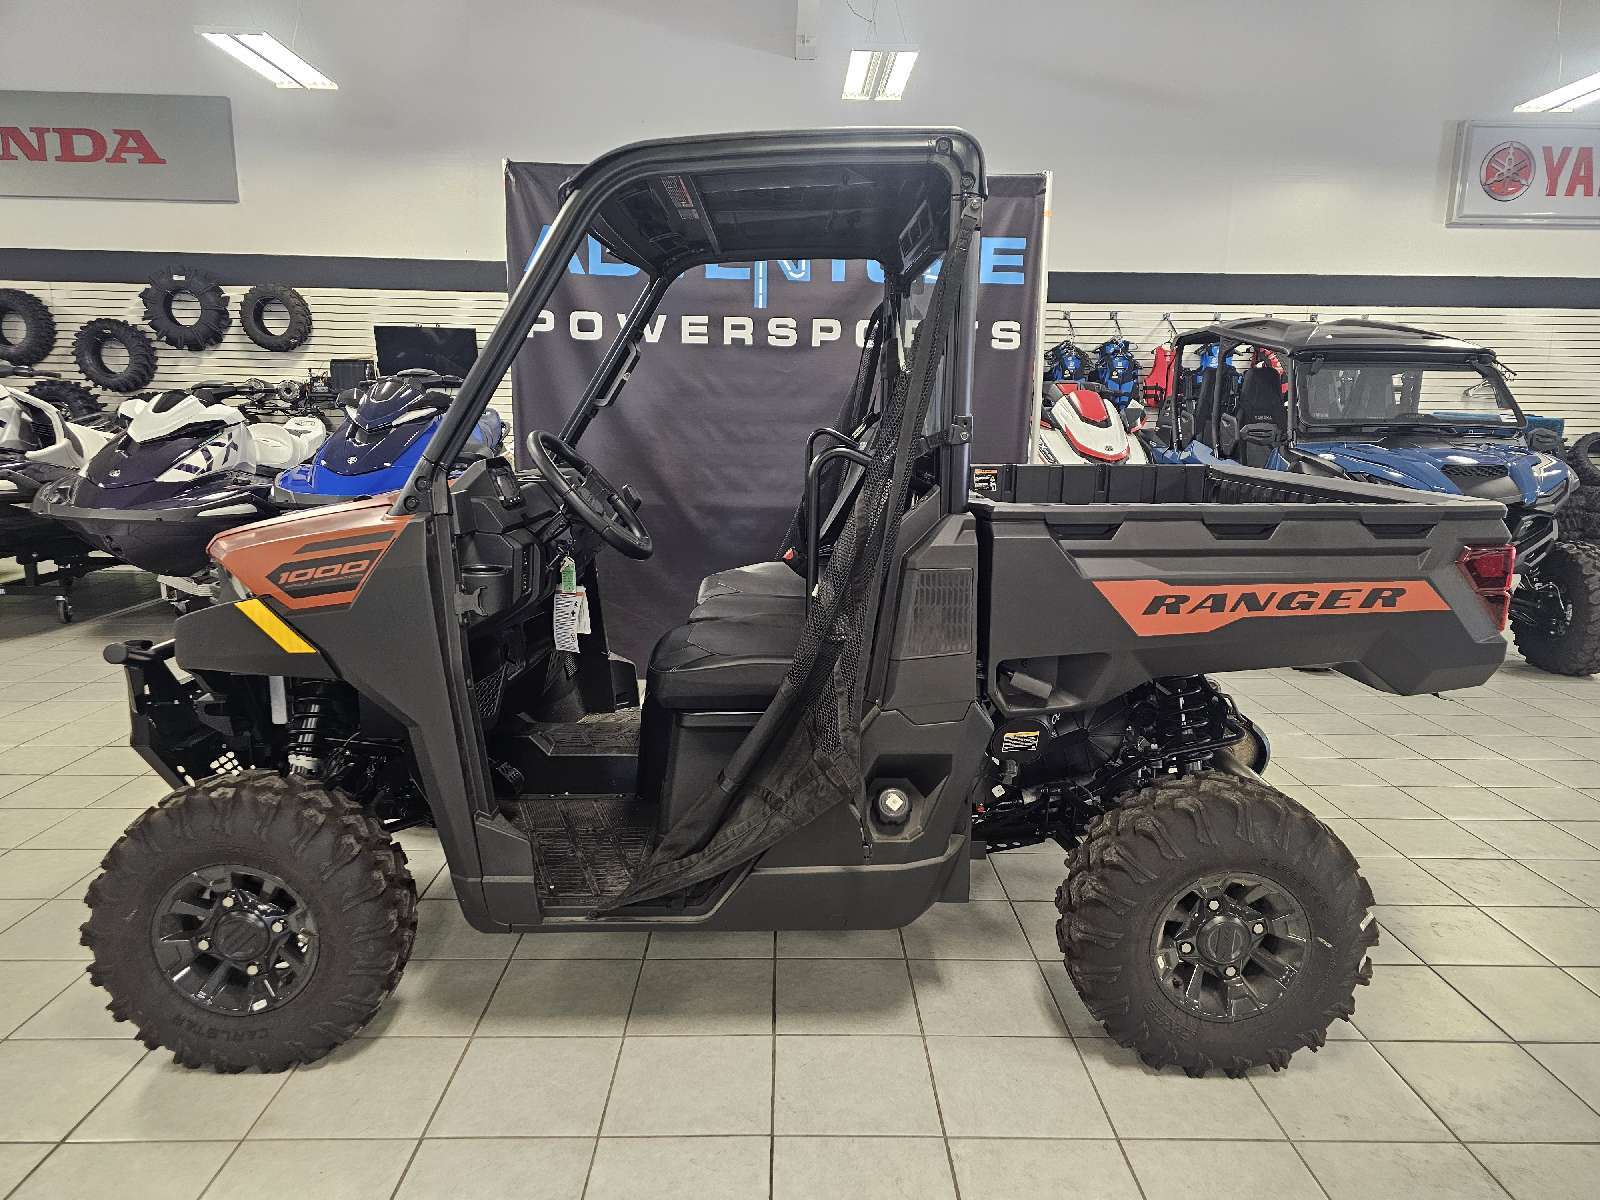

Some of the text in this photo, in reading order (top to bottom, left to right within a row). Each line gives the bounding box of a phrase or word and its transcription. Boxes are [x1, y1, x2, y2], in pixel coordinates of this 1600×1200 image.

[0, 126, 168, 165] NDA
[1542, 145, 1600, 197] YA
[526, 309, 1021, 350] POWERSPS
[278, 559, 370, 585] 1000
[1142, 587, 1407, 615] RANGER
